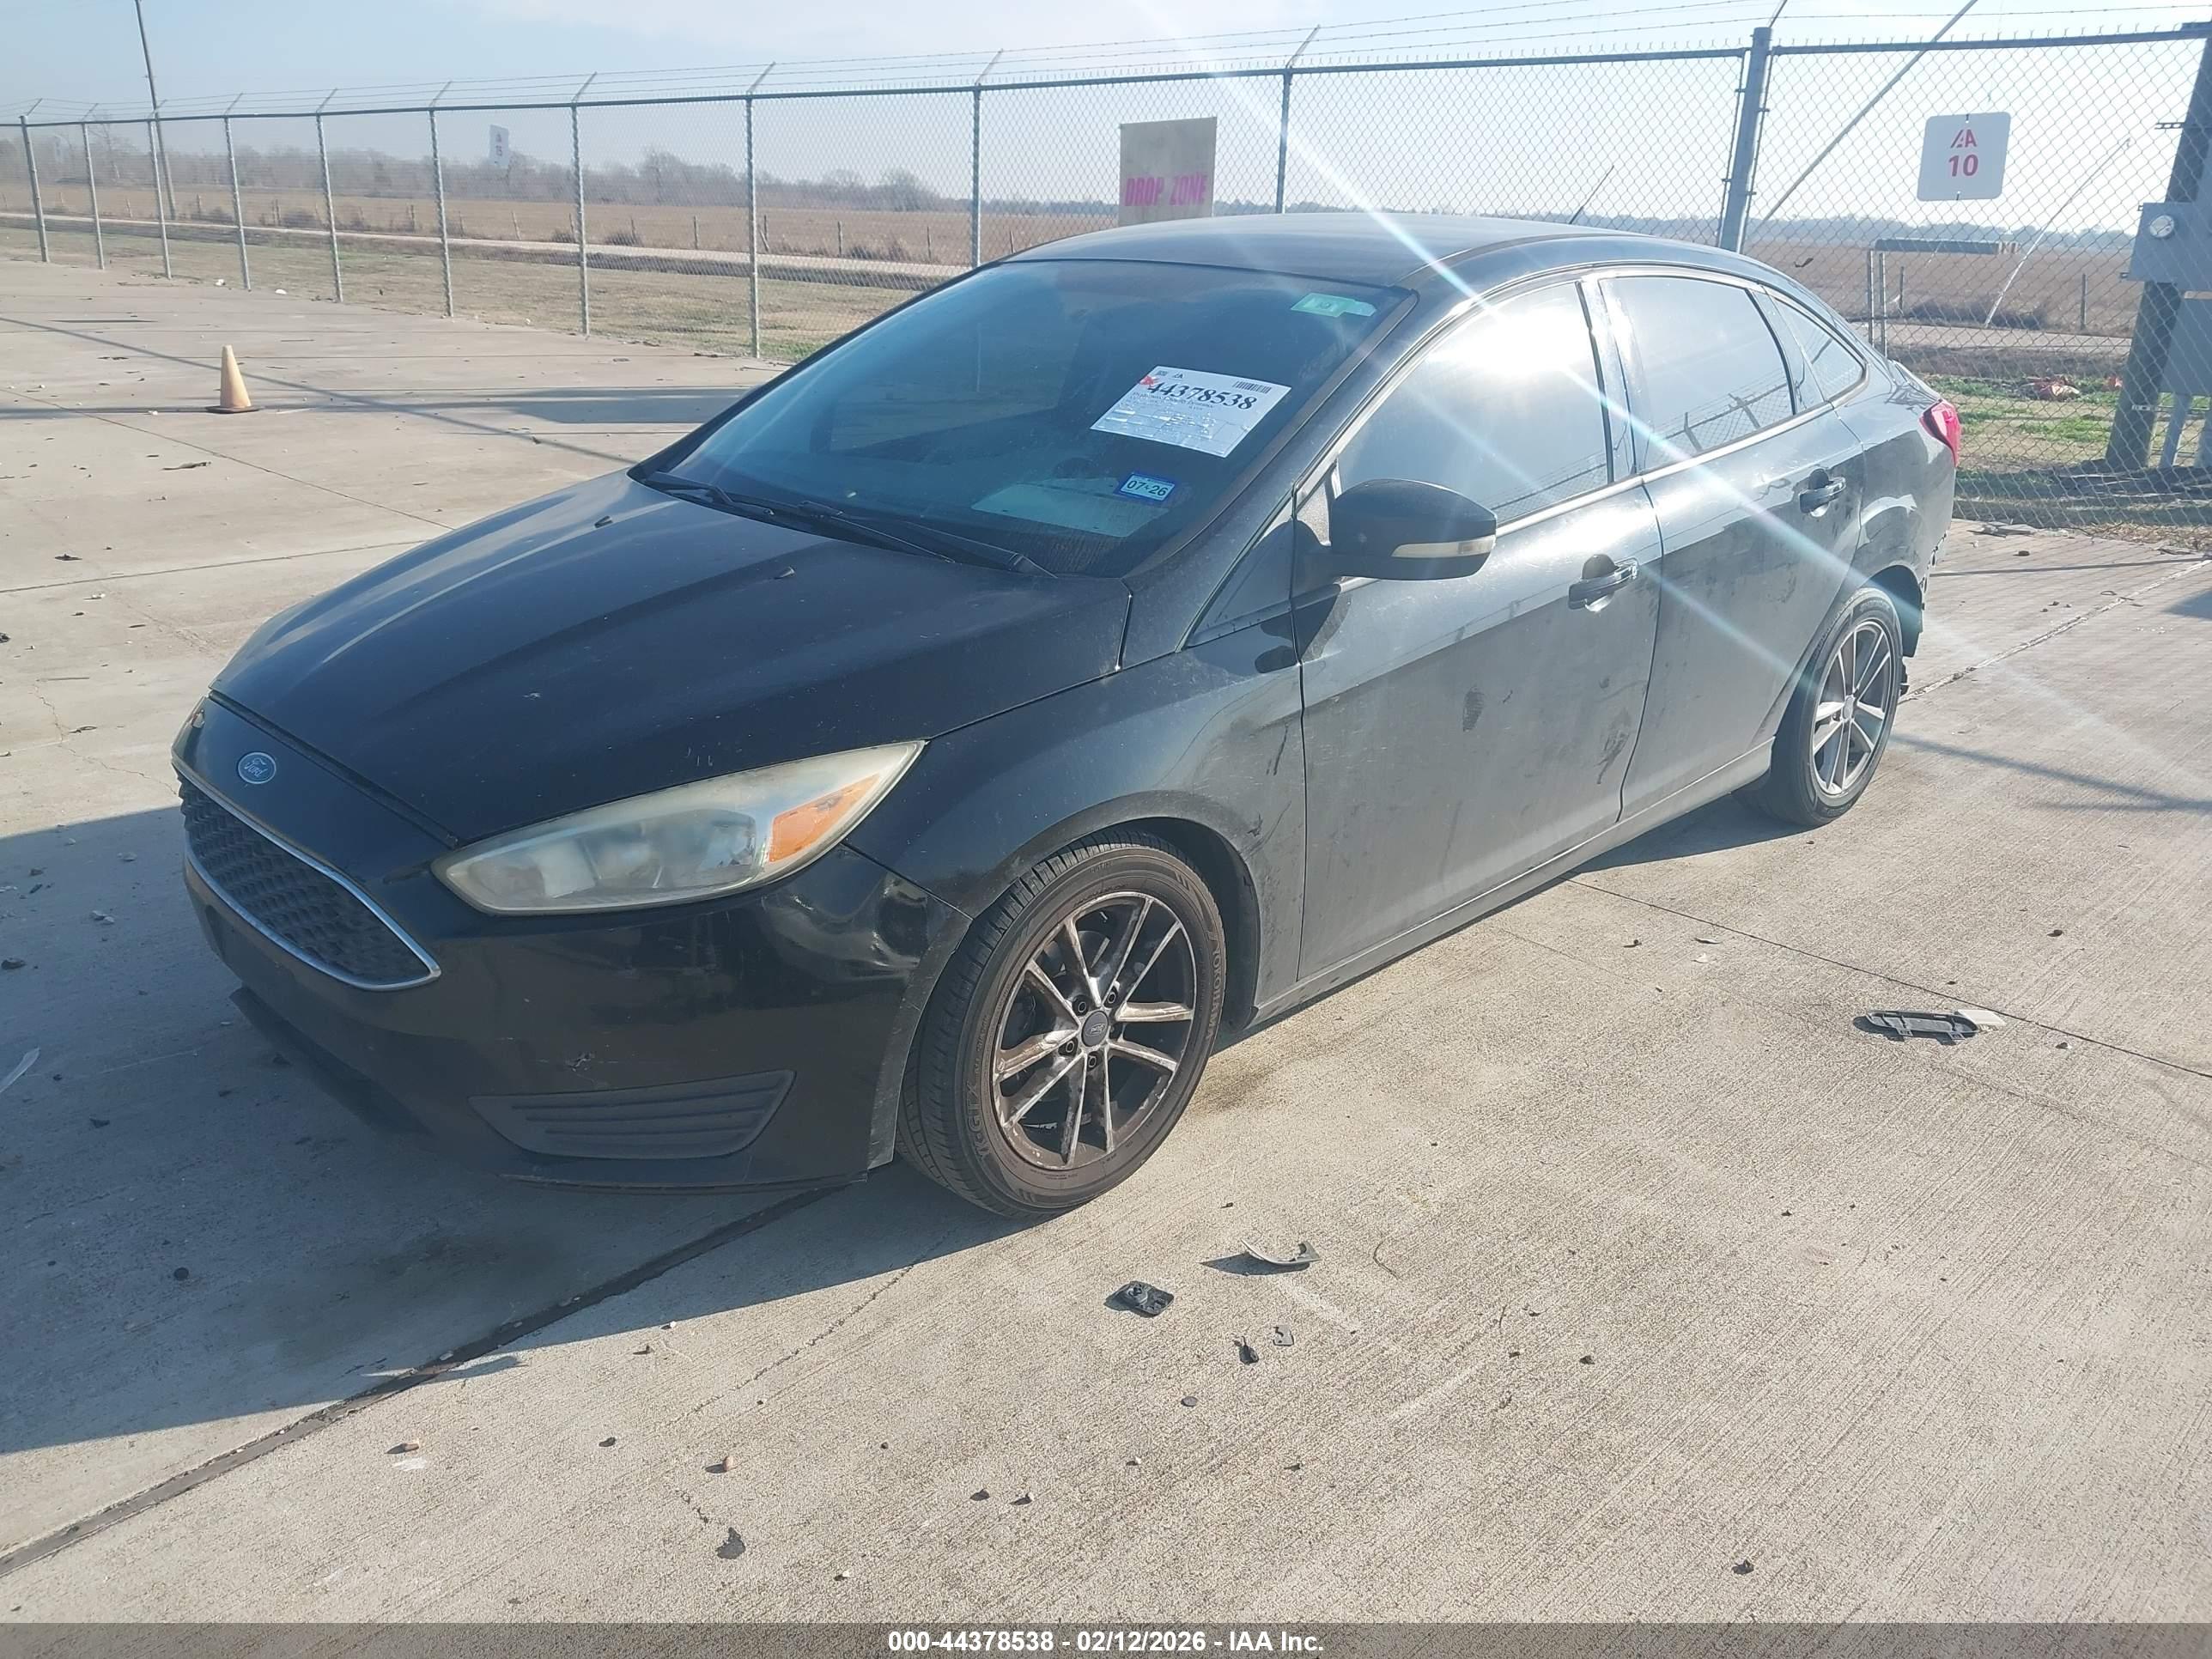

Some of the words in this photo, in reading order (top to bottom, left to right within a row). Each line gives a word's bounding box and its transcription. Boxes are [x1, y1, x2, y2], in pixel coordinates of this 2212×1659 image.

[1948, 155, 1978, 177] 10
[1124, 177, 1164, 206] DROP
[1170, 173, 1207, 205] ZONE
[1147, 382, 1257, 410] 44378538
[1205, 947, 1220, 1041] YOKOHAMA
